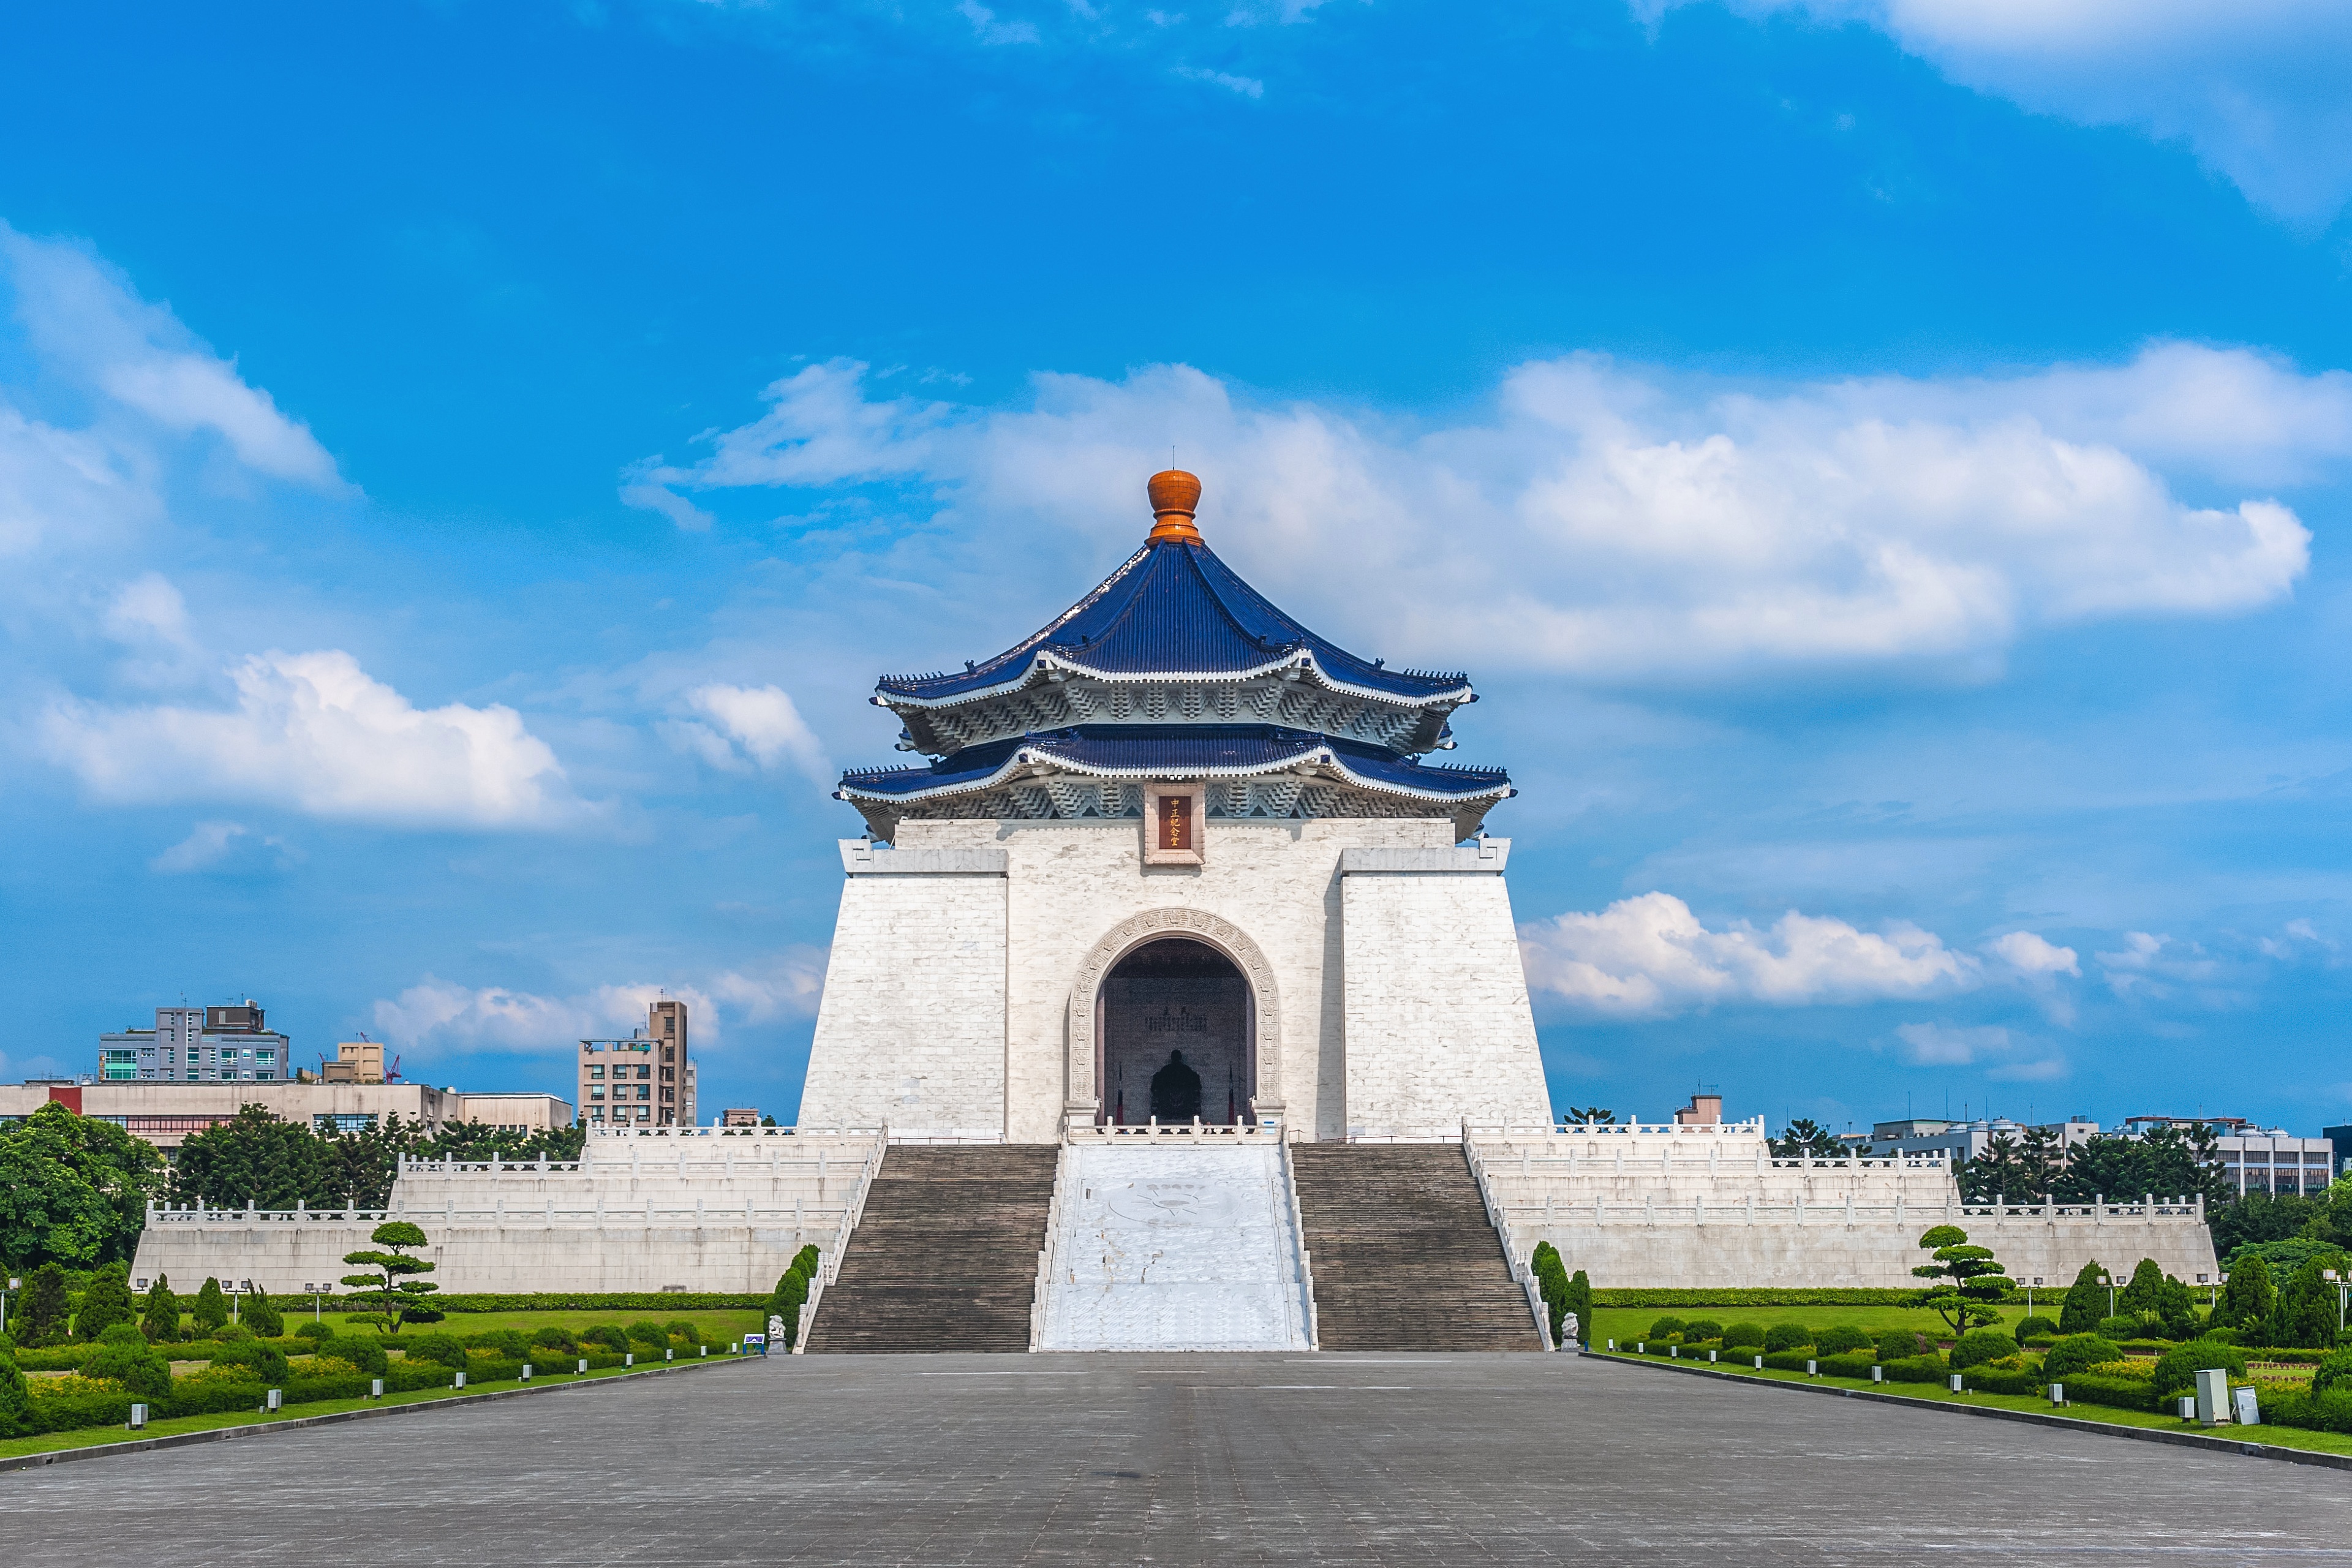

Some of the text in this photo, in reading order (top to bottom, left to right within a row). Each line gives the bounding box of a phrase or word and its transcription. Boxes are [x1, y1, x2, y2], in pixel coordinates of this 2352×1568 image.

[1170, 798, 1181, 846] 中正紀念堂
